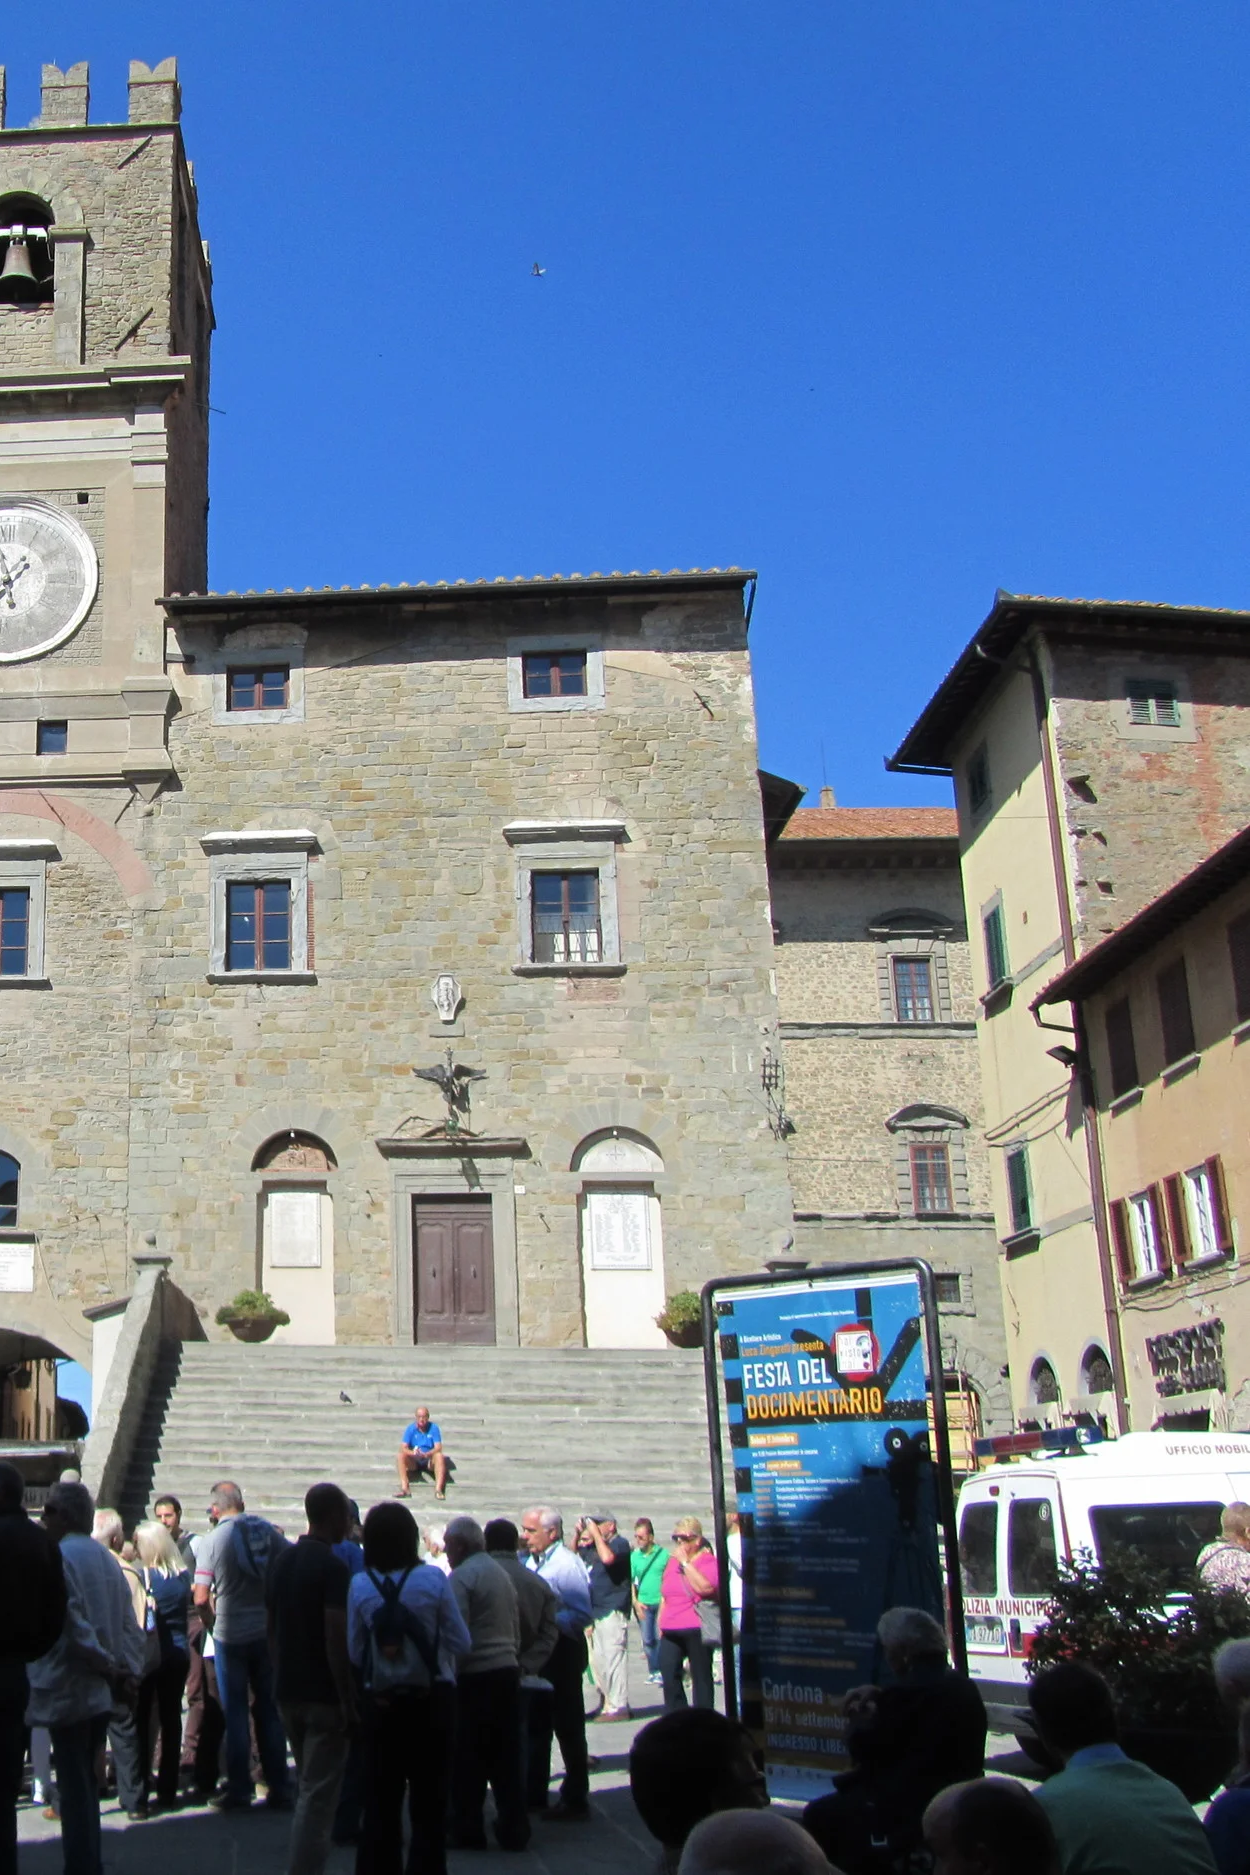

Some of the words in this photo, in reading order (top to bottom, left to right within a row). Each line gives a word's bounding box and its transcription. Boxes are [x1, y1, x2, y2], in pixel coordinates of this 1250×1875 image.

[791, 1340, 824, 1354] presenta
[742, 1361, 792, 1389] FESTA
[797, 1358, 833, 1385] DEL
[746, 1387, 882, 1419] DOCUMENTARIO
[1165, 1445, 1212, 1455] UFFICIO
[761, 1677, 823, 1704] Cortona
[764, 1706, 791, 1725] 15/16
[767, 1733, 817, 1751] INGRESSO
